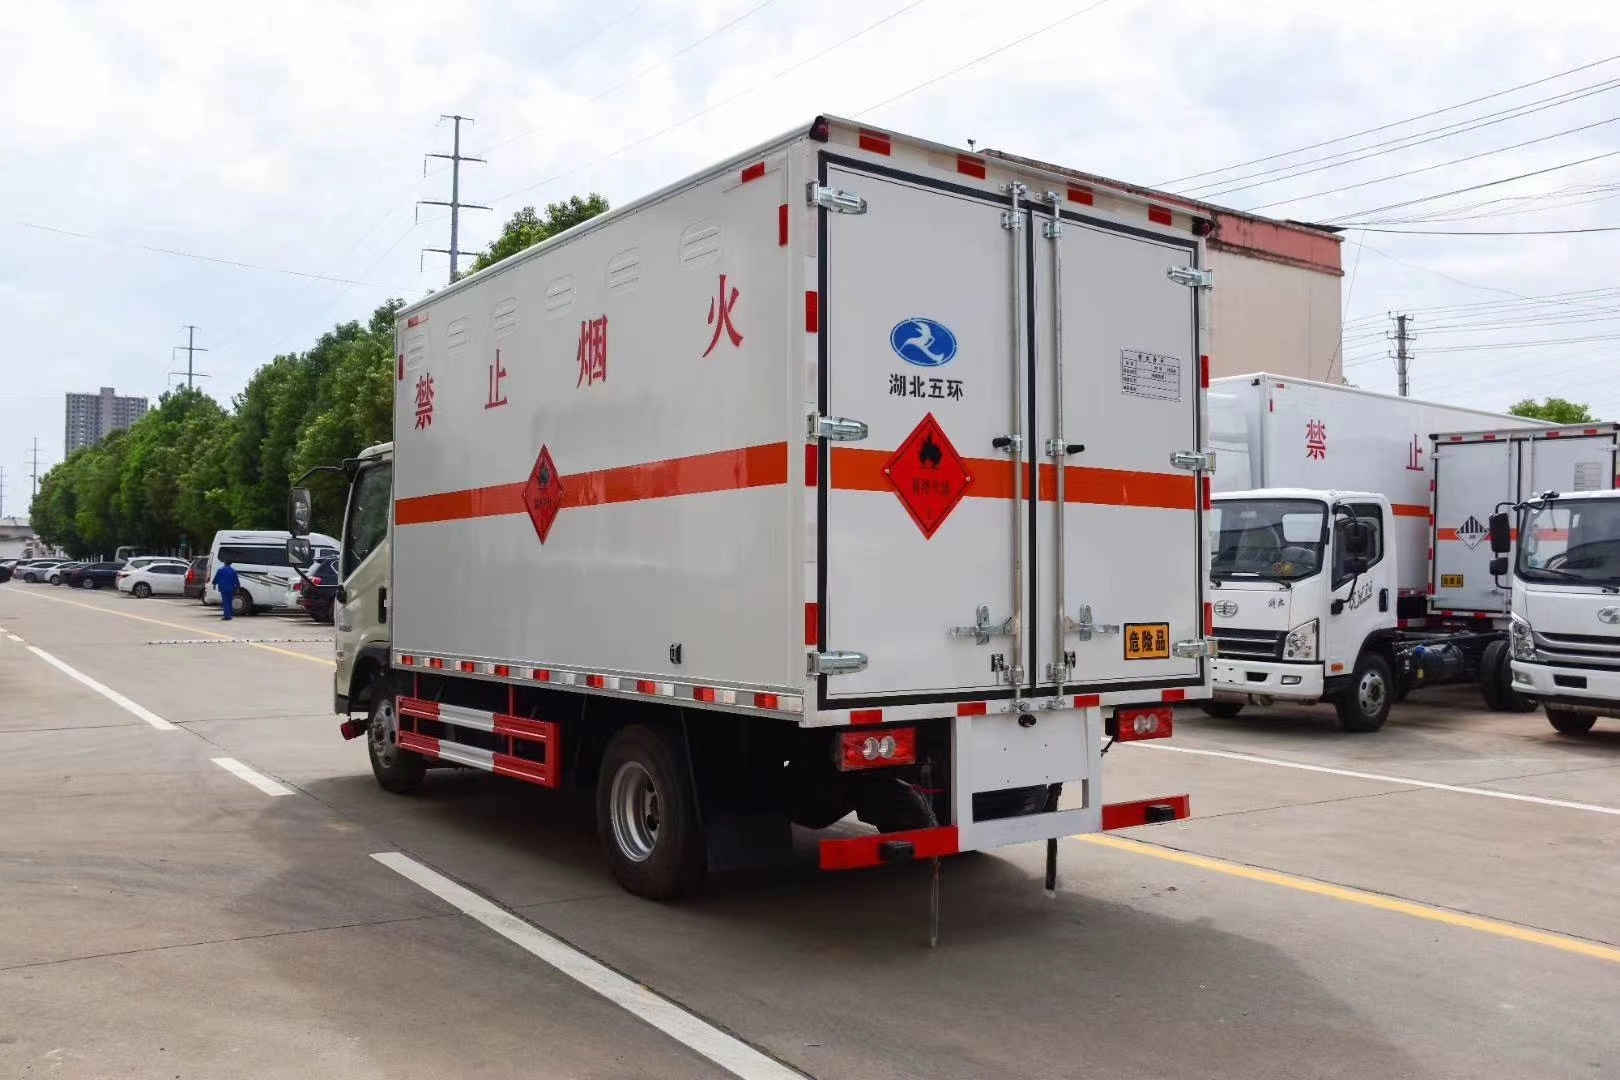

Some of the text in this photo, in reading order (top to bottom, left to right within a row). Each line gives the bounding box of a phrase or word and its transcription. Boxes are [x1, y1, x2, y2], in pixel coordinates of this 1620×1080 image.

[888, 373, 964, 401] 湖北五环
[1128, 630, 1167, 653] 危险品
